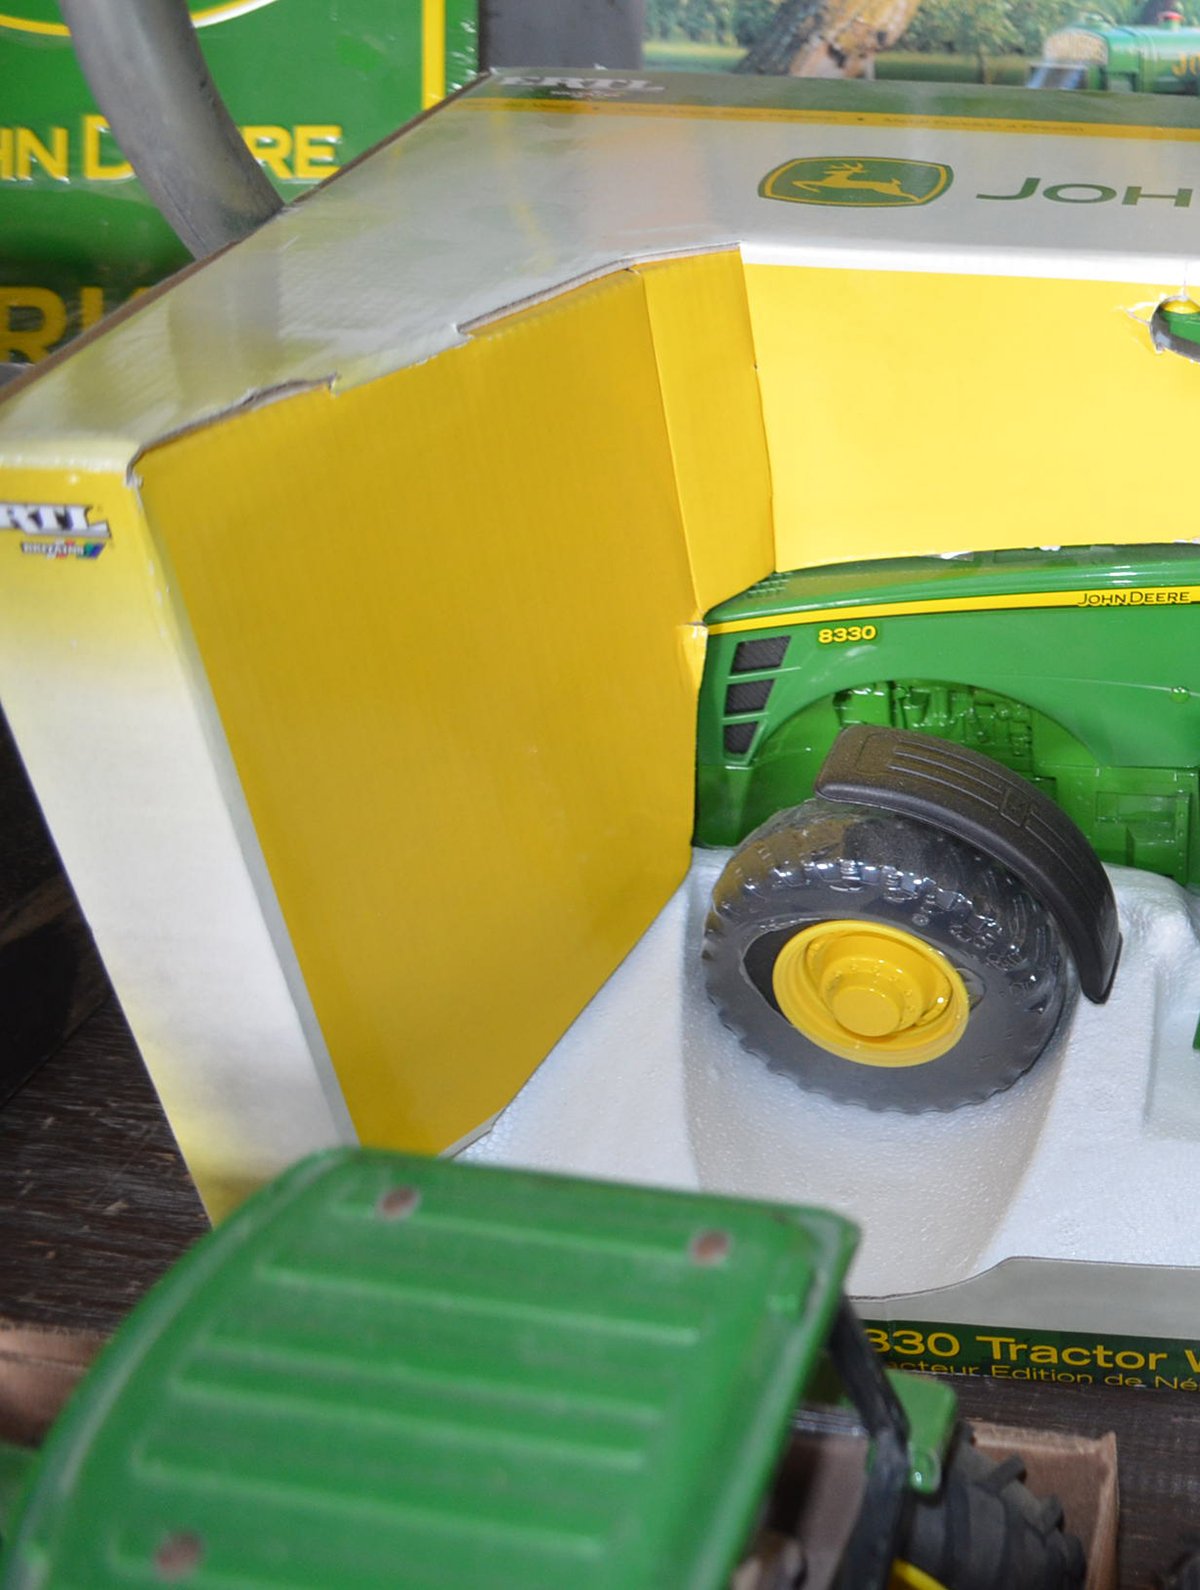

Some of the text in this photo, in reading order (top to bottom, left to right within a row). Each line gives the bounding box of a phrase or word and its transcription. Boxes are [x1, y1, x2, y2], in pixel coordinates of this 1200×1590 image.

[83, 114, 342, 180] DRE
[0, 502, 112, 538] RTL
[1077, 591, 1191, 606] JOHN DEERE
[817, 625, 877, 644] 8330
[864, 1328, 960, 1358] 330
[976, 1335, 1168, 1371] Tractor
[885, 1360, 980, 1377] acteur
[991, 1365, 1094, 1385] Edition
[1104, 1372, 1143, 1388] de
